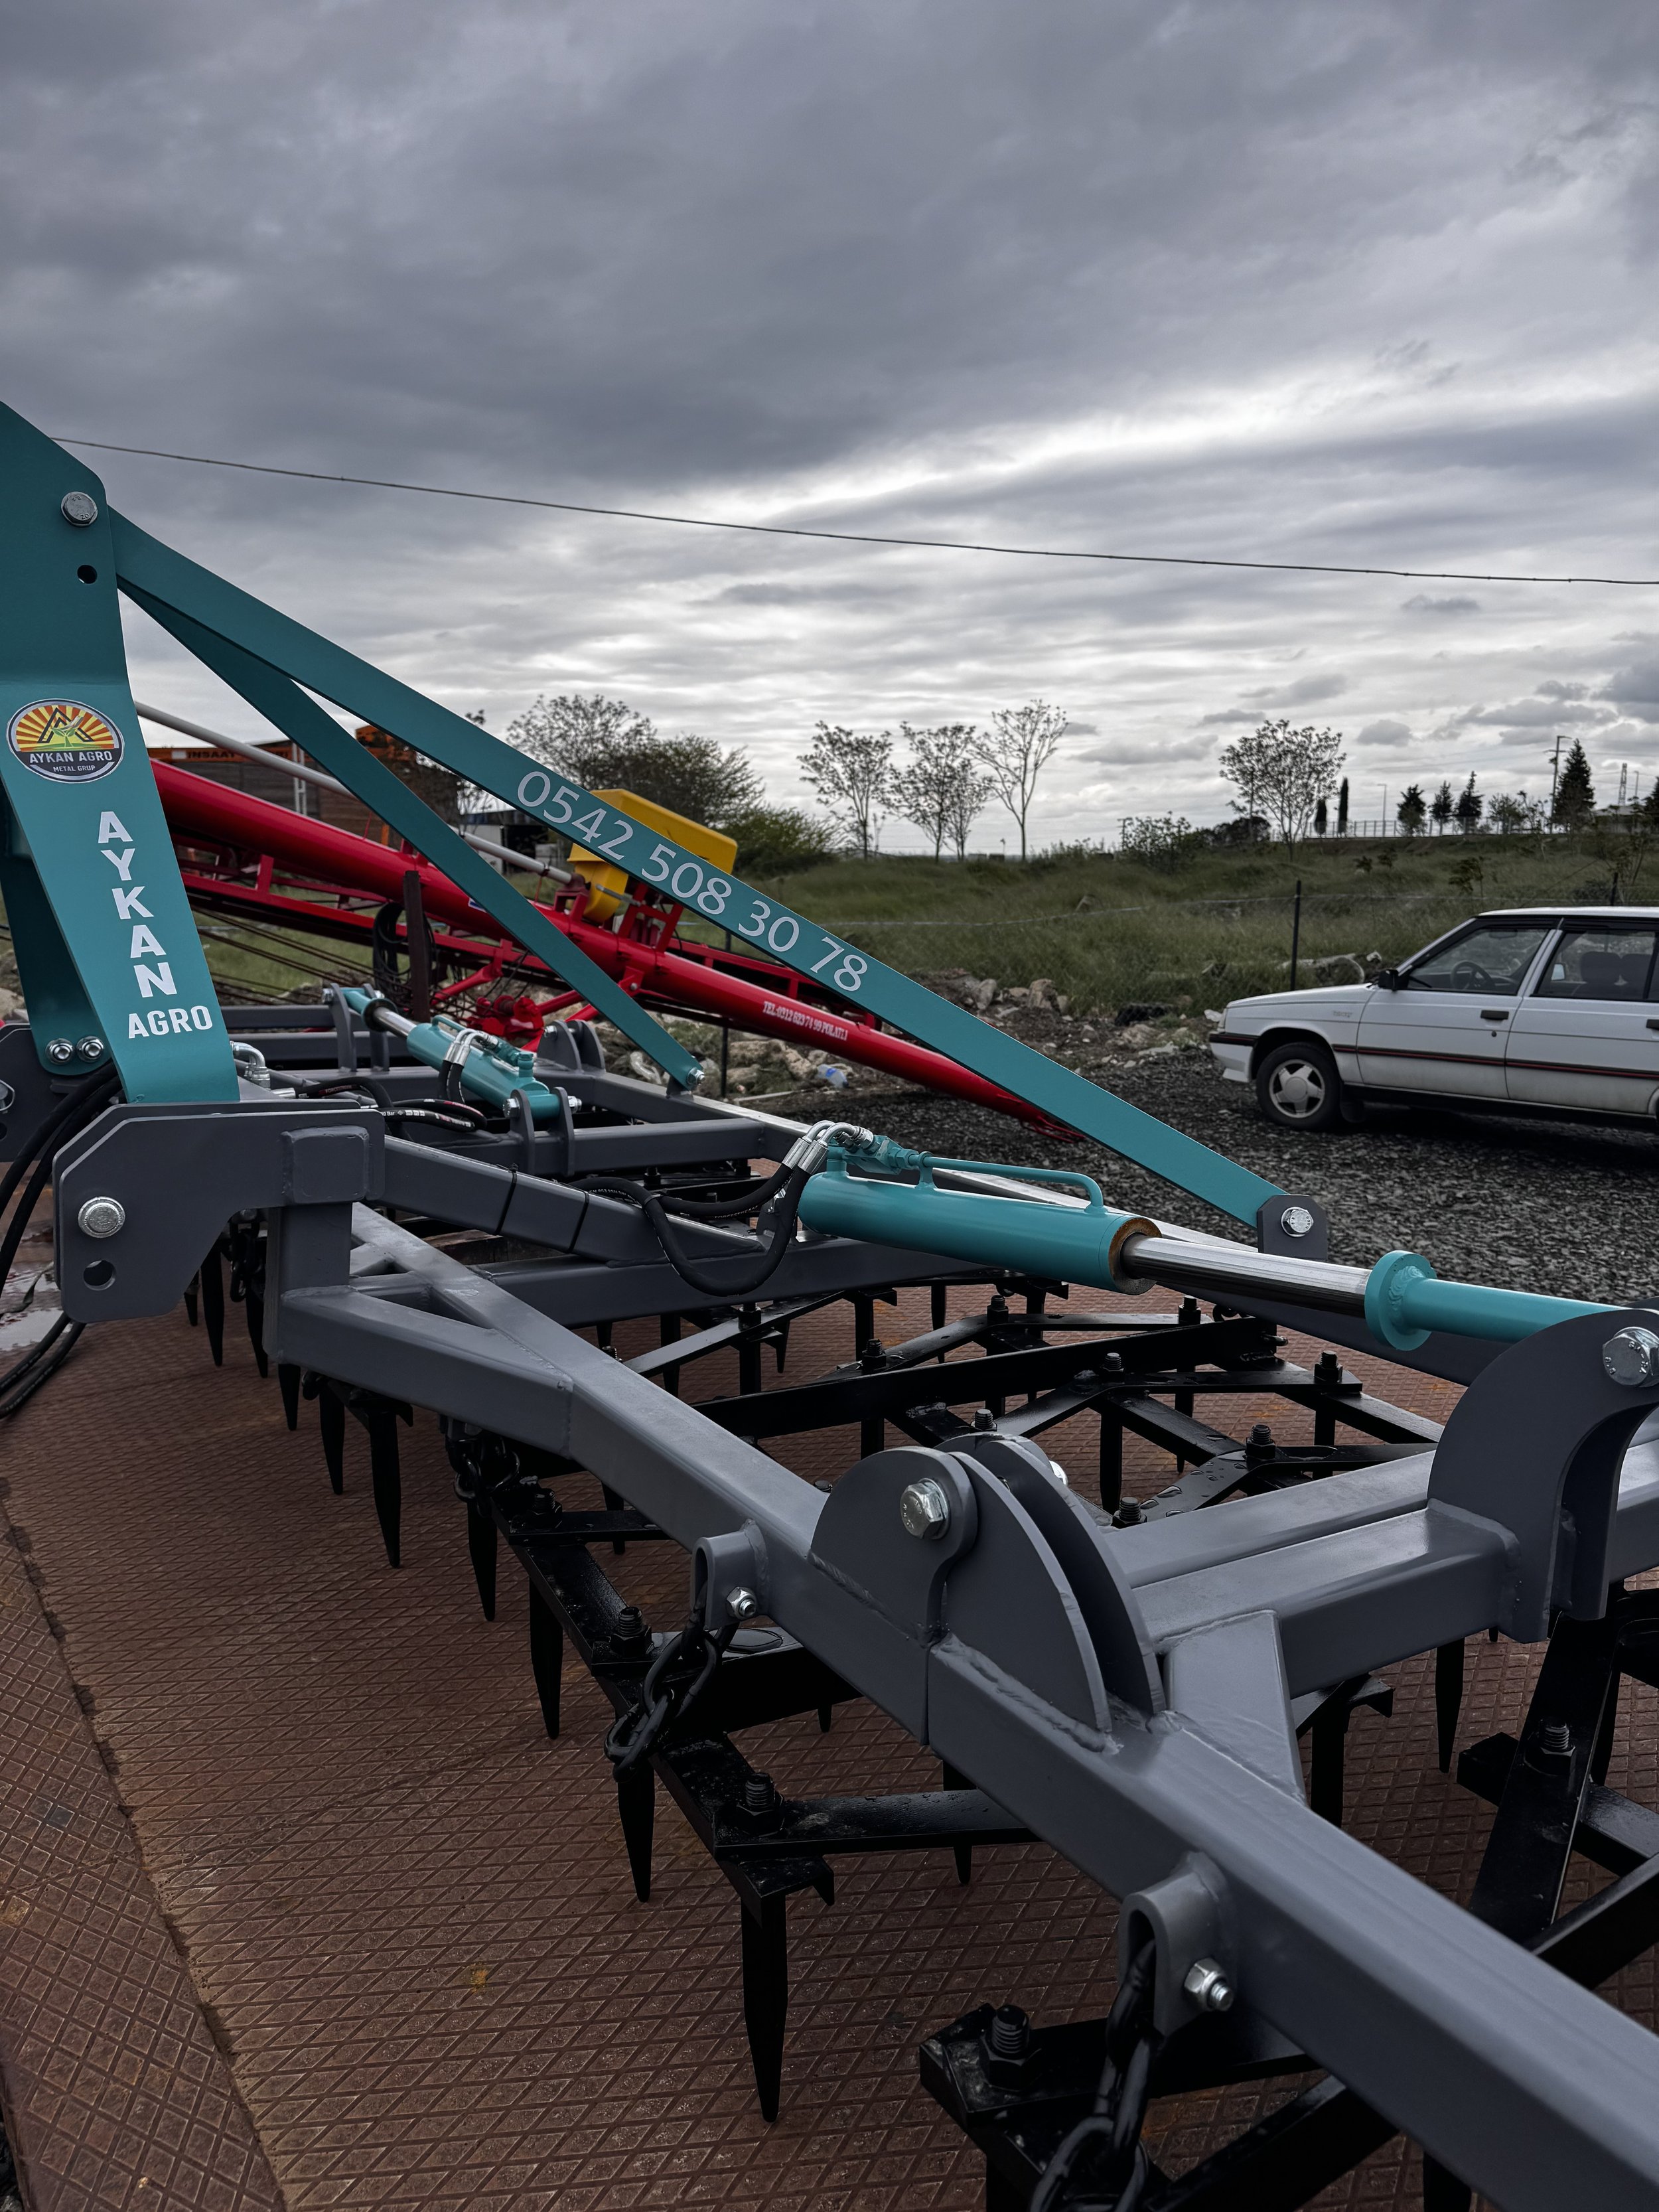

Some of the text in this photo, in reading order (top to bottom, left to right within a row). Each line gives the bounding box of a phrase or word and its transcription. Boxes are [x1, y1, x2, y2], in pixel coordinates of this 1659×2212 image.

[29, 751, 113, 763] AYKAN AGRO
[98, 811, 178, 998] AYKAN
[516, 771, 868, 992] 0542 508 30 78
[128, 1005, 213, 1039] AGRO
